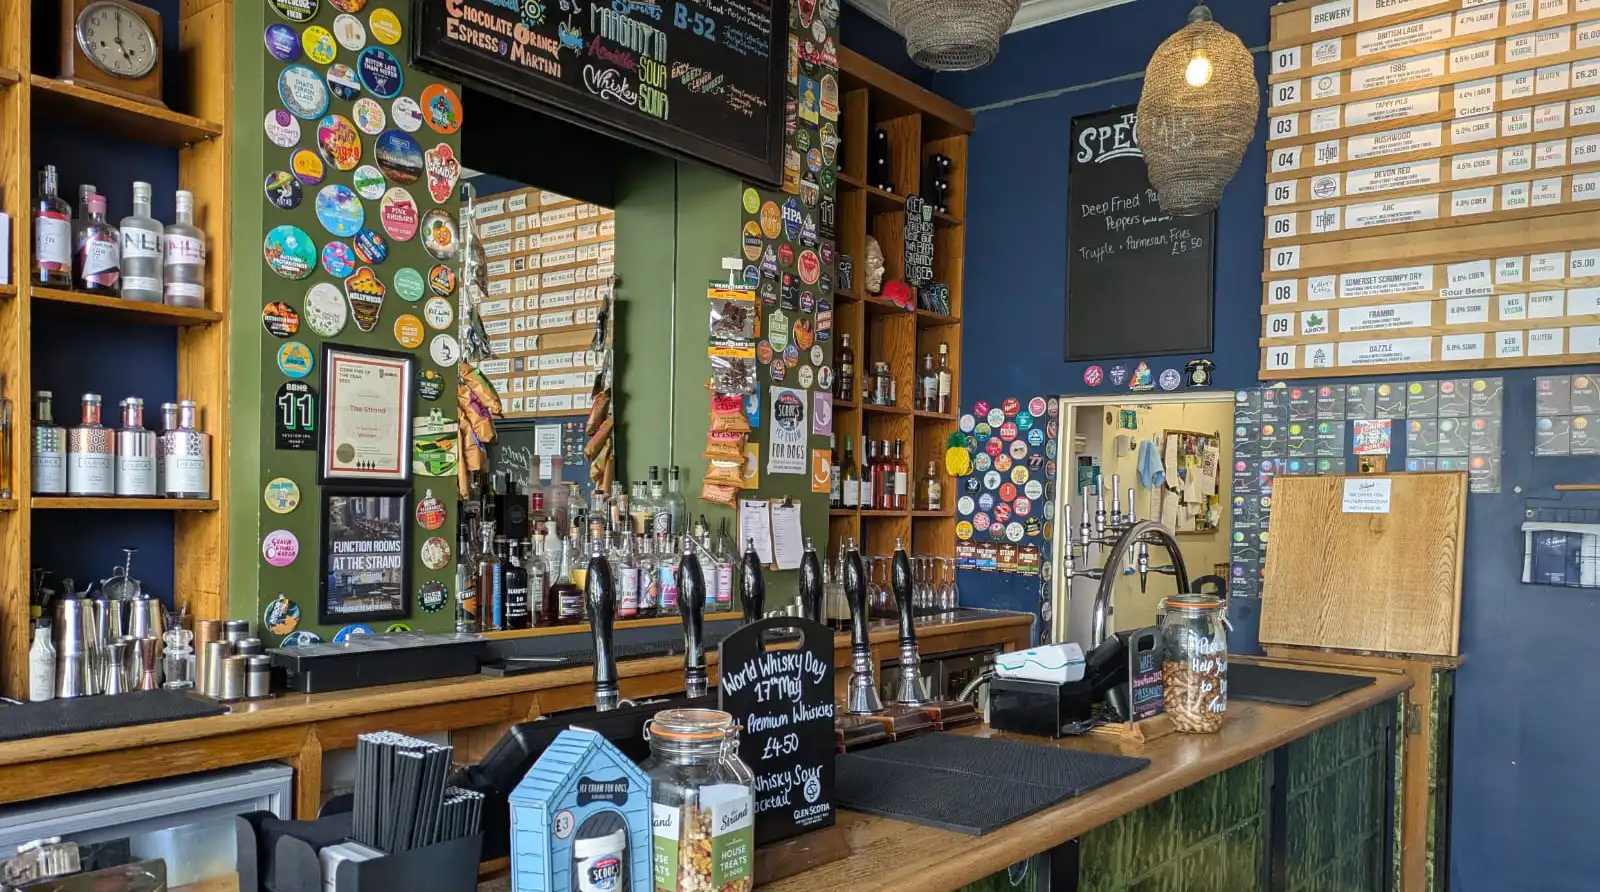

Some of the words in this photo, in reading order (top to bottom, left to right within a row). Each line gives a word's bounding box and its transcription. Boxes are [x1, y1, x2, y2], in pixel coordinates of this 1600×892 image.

[673, 1, 716, 42] B-52
[1314, 7, 1351, 24] BREWERY
[1475, 13, 1494, 22] LAGER
[446, 0, 513, 37] CHOCOLATE
[513, 22, 560, 60] ORANGE
[1377, 27, 1401, 40] BRITISH
[1403, 23, 1424, 35] LAGER
[1537, 32, 1560, 42] GLUTEN
[510, 41, 562, 78] MARTINI
[1279, 52, 1293, 67] 01
[1470, 51, 1490, 61] LAGER
[638, 56, 667, 90] SOUR
[583, 64, 638, 105] Whiskey
[638, 83, 669, 121] SOUR
[1279, 86, 1294, 101] 02
[1460, 105, 1491, 116] Ciders
[1573, 105, 1596, 116] £5.20
[1276, 120, 1291, 134] 03
[1507, 122, 1528, 132] VEGAN
[1374, 131, 1411, 144] RUSHWOOD
[1278, 152, 1293, 167] 04
[1508, 158, 1528, 166] VEGAN
[1374, 168, 1396, 179] DEVON
[1397, 166, 1411, 176] RED
[1275, 186, 1290, 201] 05
[1573, 182, 1596, 193] £6.00
[1081, 202, 1109, 218] Deep
[1111, 193, 1140, 213] Fried
[1382, 203, 1395, 211] ABC
[1470, 197, 1487, 205] CIDER
[1507, 198, 1526, 206] VEGAN
[391, 207, 407, 215] PINK
[783, 206, 802, 224] HPA
[1105, 215, 1140, 232] Peppers
[1275, 219, 1290, 233] 06
[1079, 242, 1115, 263] Truffle
[1126, 235, 1169, 250] Parmesan
[1169, 228, 1191, 243] Fries
[1277, 251, 1293, 266] 07
[1572, 258, 1595, 269] £5.00
[1345, 275, 1377, 287] SOMERSET
[1378, 273, 1408, 284] SCRUMPY
[1409, 272, 1422, 281] DRY
[1275, 286, 1291, 300] 08
[1465, 287, 1492, 295] Beers
[1368, 309, 1395, 318] FRAMBO
[1503, 306, 1523, 314] VEGAN
[1272, 318, 1288, 332] 09
[1369, 344, 1393, 353] DAZZLE
[1276, 352, 1289, 366] 10
[279, 393, 313, 431] 11
[364, 406, 386, 414] Strand
[772, 443, 785, 459] FOR
[786, 443, 805, 460] DOGS
[333, 540, 373, 553] FUNCTION
[373, 539, 401, 552] ROOMS
[332, 556, 346, 571] AT
[346, 556, 364, 569] THE
[365, 555, 401, 570] STRAND
[1192, 658, 1214, 673] Help
[722, 659, 757, 697] World
[758, 651, 803, 677] Whisky
[804, 650, 828, 685] Day
[754, 678, 779, 702] 17th
[778, 676, 803, 703] May
[1200, 680, 1213, 693] to
[747, 711, 789, 735] Premium
[792, 700, 834, 724] Whiskies
[793, 764, 824, 786] Sour
[605, 784, 614, 793] FOR
[614, 784, 627, 793] DOGS
[754, 789, 791, 812] ocktail
[720, 802, 748, 830] Strand
[793, 807, 809, 820] GLEN
[809, 802, 831, 816] SCOTIA
[722, 845, 746, 860] HOUSE
[720, 855, 747, 872] TREATS
